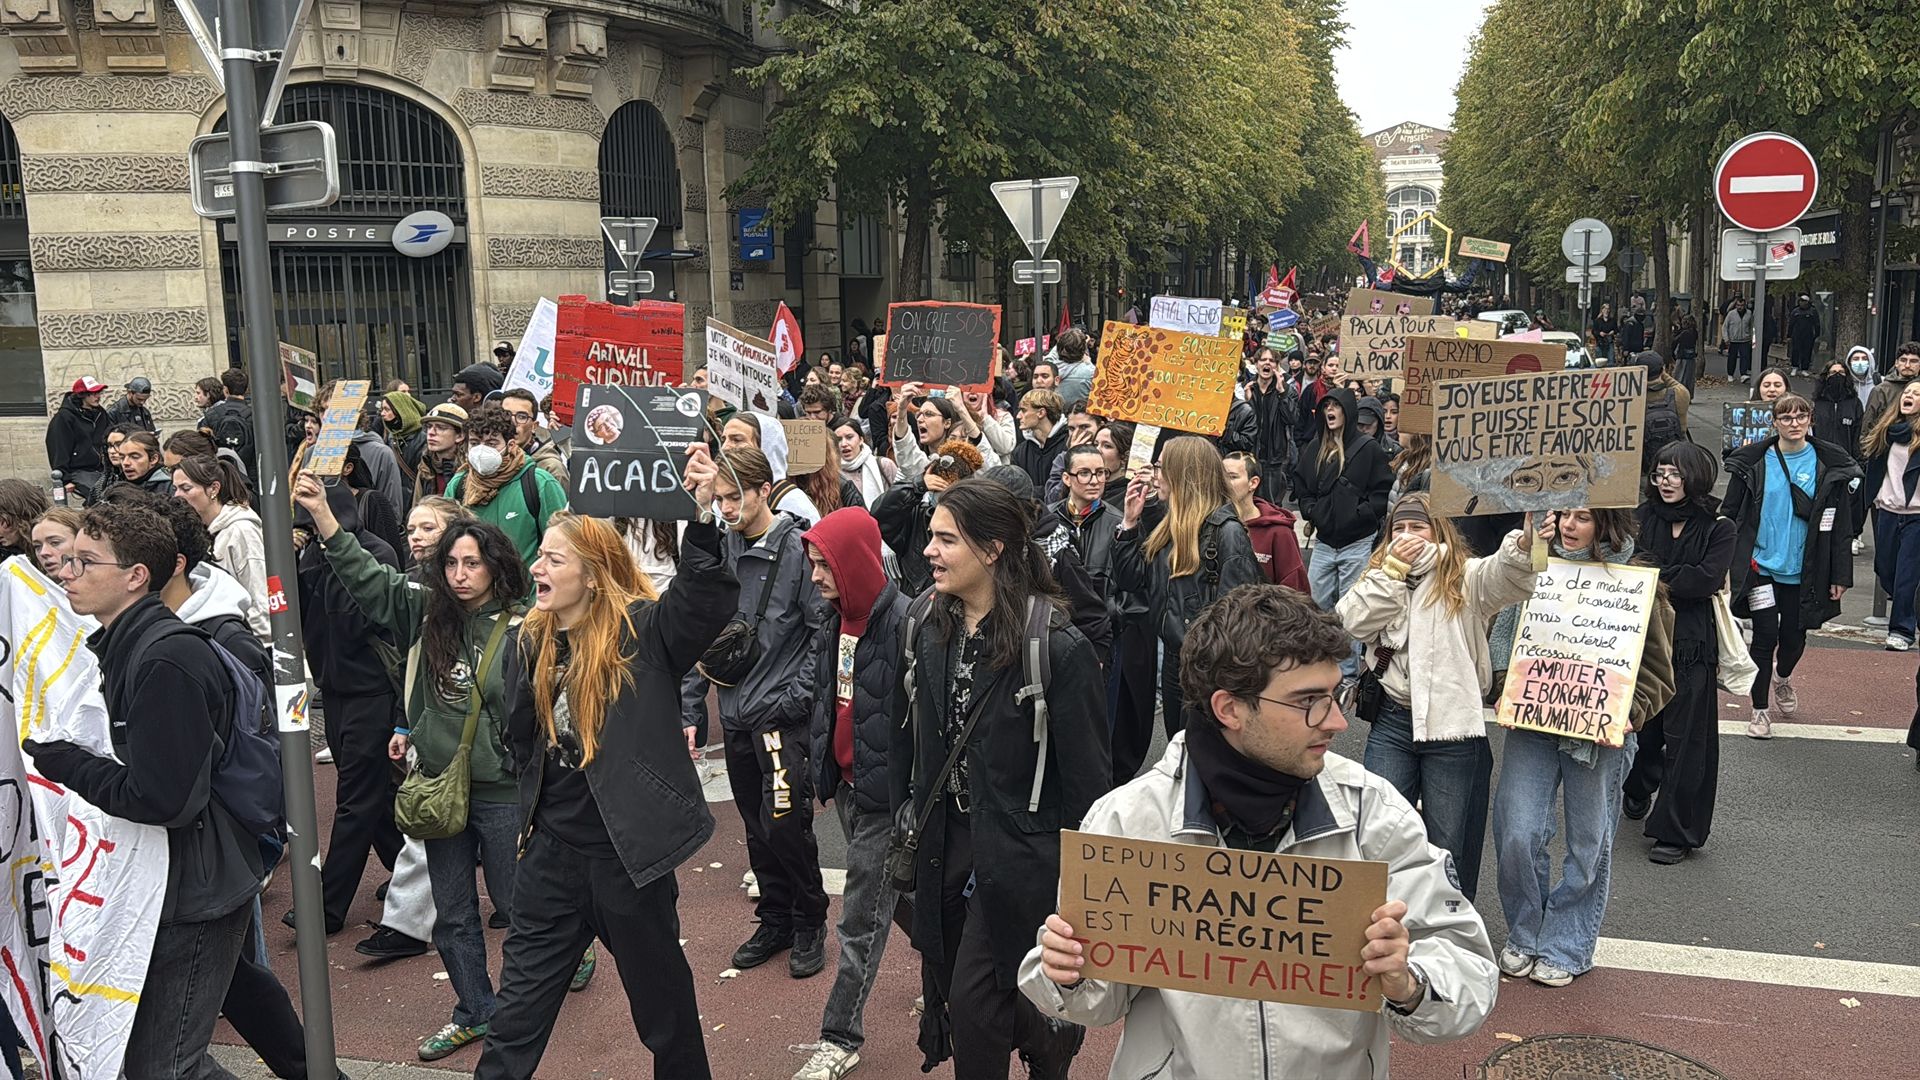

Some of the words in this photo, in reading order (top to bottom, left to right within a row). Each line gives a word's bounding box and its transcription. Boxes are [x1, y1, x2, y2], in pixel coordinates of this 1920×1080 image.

[287, 227, 376, 239] POSTE
[1151, 299, 1182, 321] ATTAL
[901, 311, 921, 331] ON
[925, 311, 951, 333] CRIE
[955, 311, 988, 337] SOS
[1399, 315, 1437, 334] POUR
[710, 330, 728, 348] VOTRE
[911, 335, 957, 354] ENVOIE
[1368, 335, 1406, 350] CASS
[708, 347, 718, 361] JE
[735, 361, 773, 388] VENTOUSE
[1162, 351, 1186, 366] LES
[1343, 352, 1365, 374] LÀ
[1367, 351, 1399, 373] POUR
[893, 358, 913, 378] LES
[923, 358, 968, 383] CRS
[710, 372, 719, 385] LA
[721, 377, 742, 399] CHATTE
[1175, 390, 1194, 400] LES
[1404, 386, 1433, 406] DÉL
[1438, 379, 1528, 410] JOYEUSE
[1437, 414, 1466, 440] ET
[1471, 406, 1540, 436] PUISSE
[1544, 402, 1572, 429] LE
[1571, 398, 1634, 428] SORT
[1732, 408, 1746, 425] IF
[1751, 409, 1774, 425] NO
[1435, 433, 1483, 464] VOUS
[1539, 425, 1637, 455] FAVORABLE
[579, 456, 678, 494] ACAB
[1565, 568, 1591, 590] de
[1577, 593, 1640, 614] travailler
[1523, 611, 1562, 623] mais
[1519, 626, 1533, 641] le
[1553, 630, 1618, 650] matériel
[1527, 658, 1607, 687] AMPUTER
[1597, 656, 1632, 671] pour
[762, 730, 792, 809] NIKE
[1081, 843, 1186, 872] DEPUIS
[1205, 850, 1343, 892] QUAND
[1083, 873, 1130, 905] LA
[1147, 881, 1325, 926] FRANCE
[1085, 910, 1133, 932] EST
[1150, 918, 1186, 938] UN
[1194, 917, 1333, 958] RÉGIME
